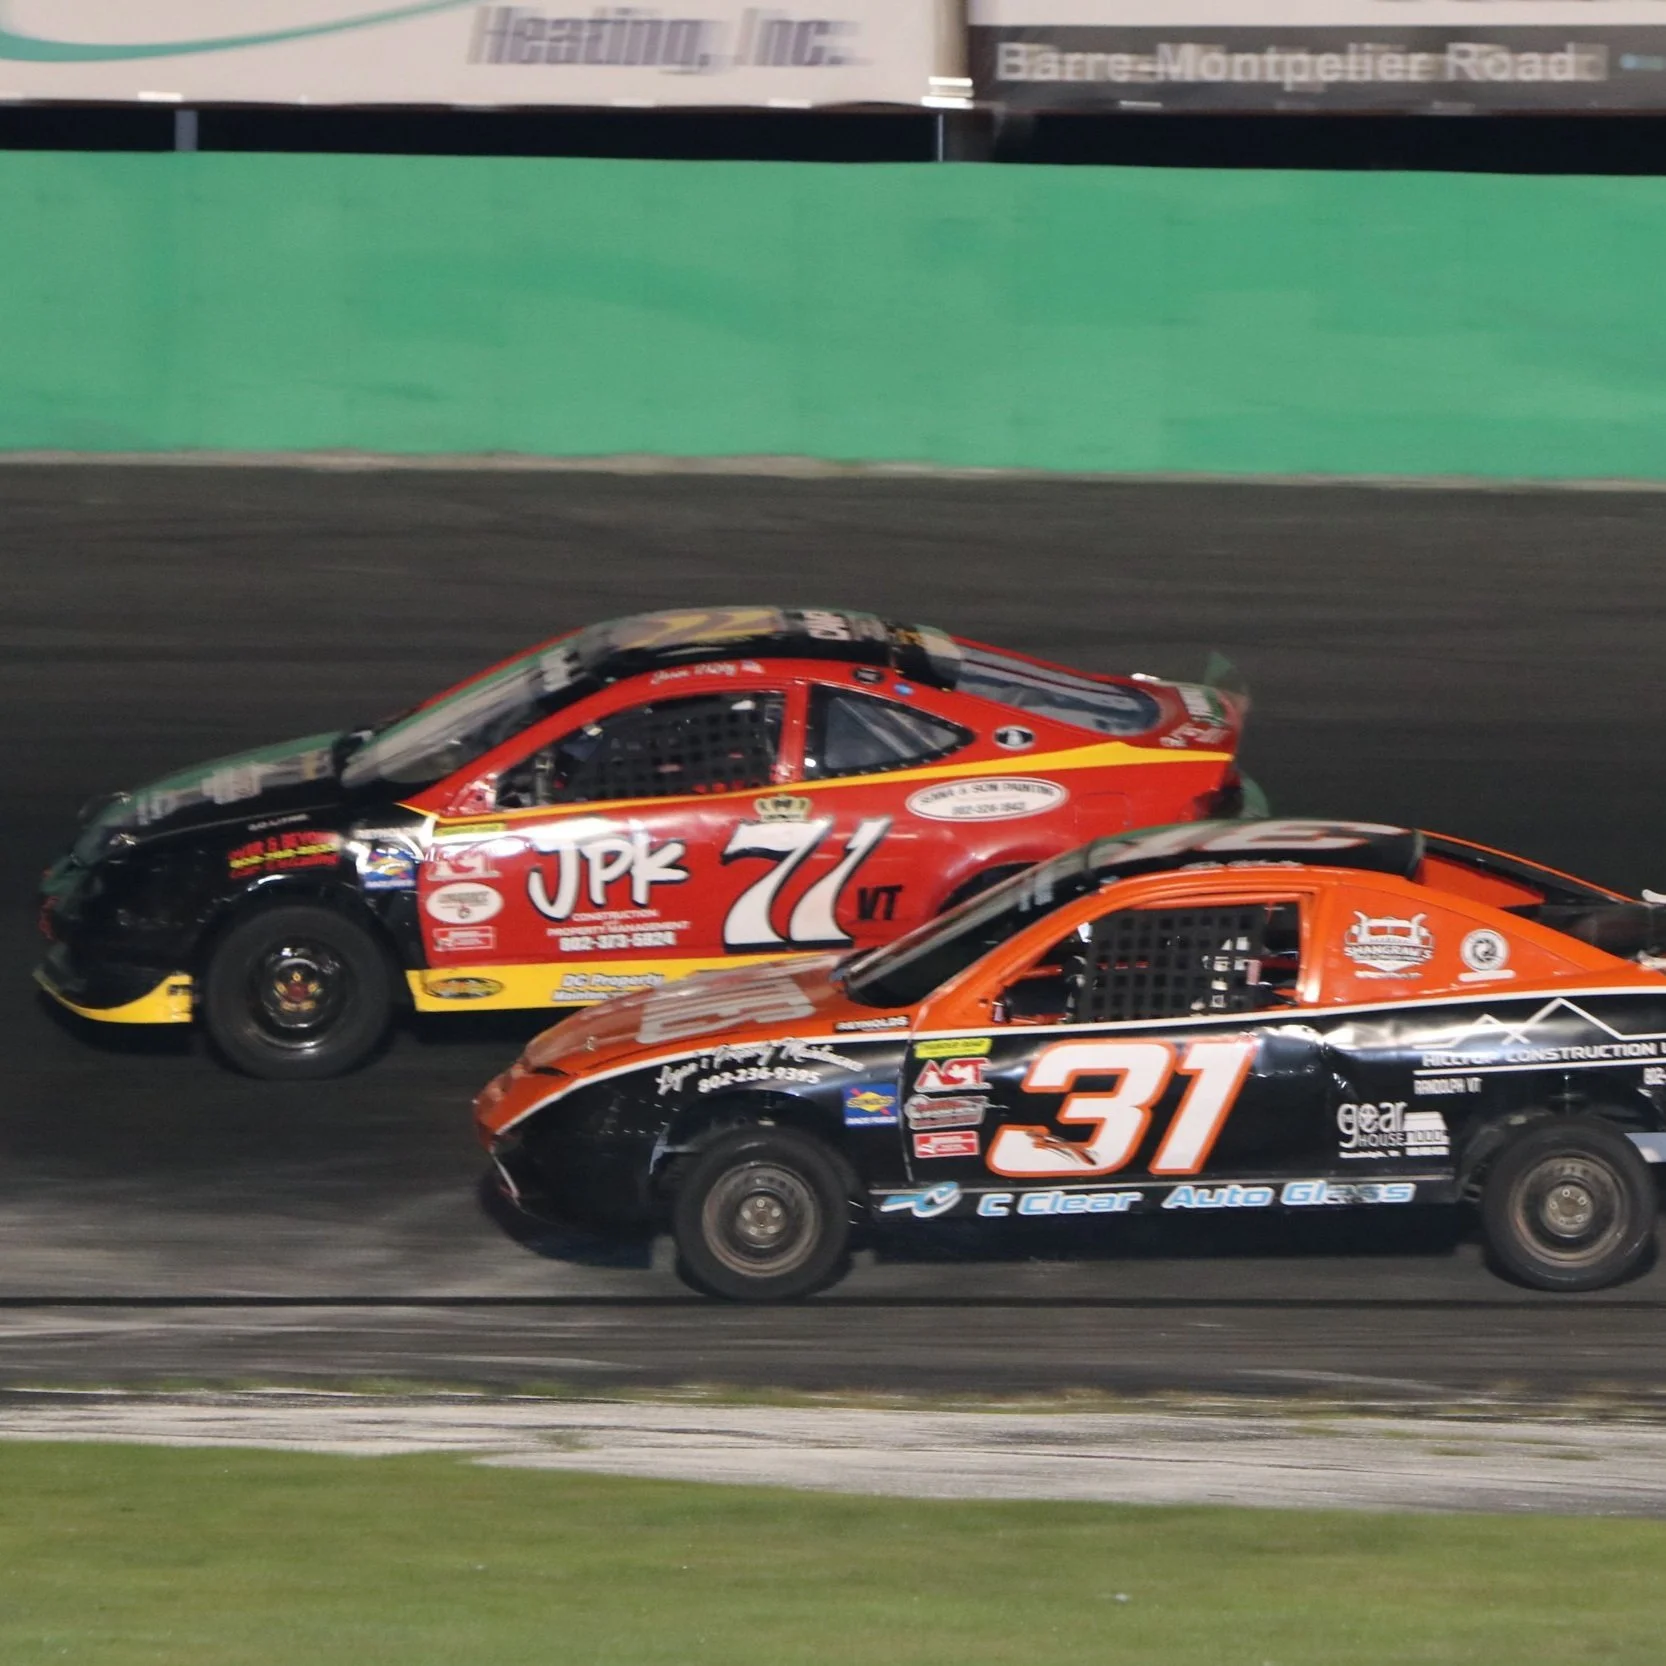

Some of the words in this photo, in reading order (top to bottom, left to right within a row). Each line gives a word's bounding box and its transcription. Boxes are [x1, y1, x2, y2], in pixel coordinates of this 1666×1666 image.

[996, 42, 1430, 91] Barre-Montpelier
[1443, 42, 1608, 82] Road
[527, 817, 690, 922] JPK
[721, 813, 893, 953] 71
[857, 884, 904, 921] VT
[1505, 1042, 1657, 1062] CONSTRUCTION
[914, 1058, 992, 1093] ACT
[986, 1038, 1260, 1178] 31
[1337, 1101, 1408, 1148] gear
[1359, 1132, 1405, 1147] HOUSE
[1017, 1187, 1143, 1216] Clear
[1162, 1185, 1275, 1210] Auto
